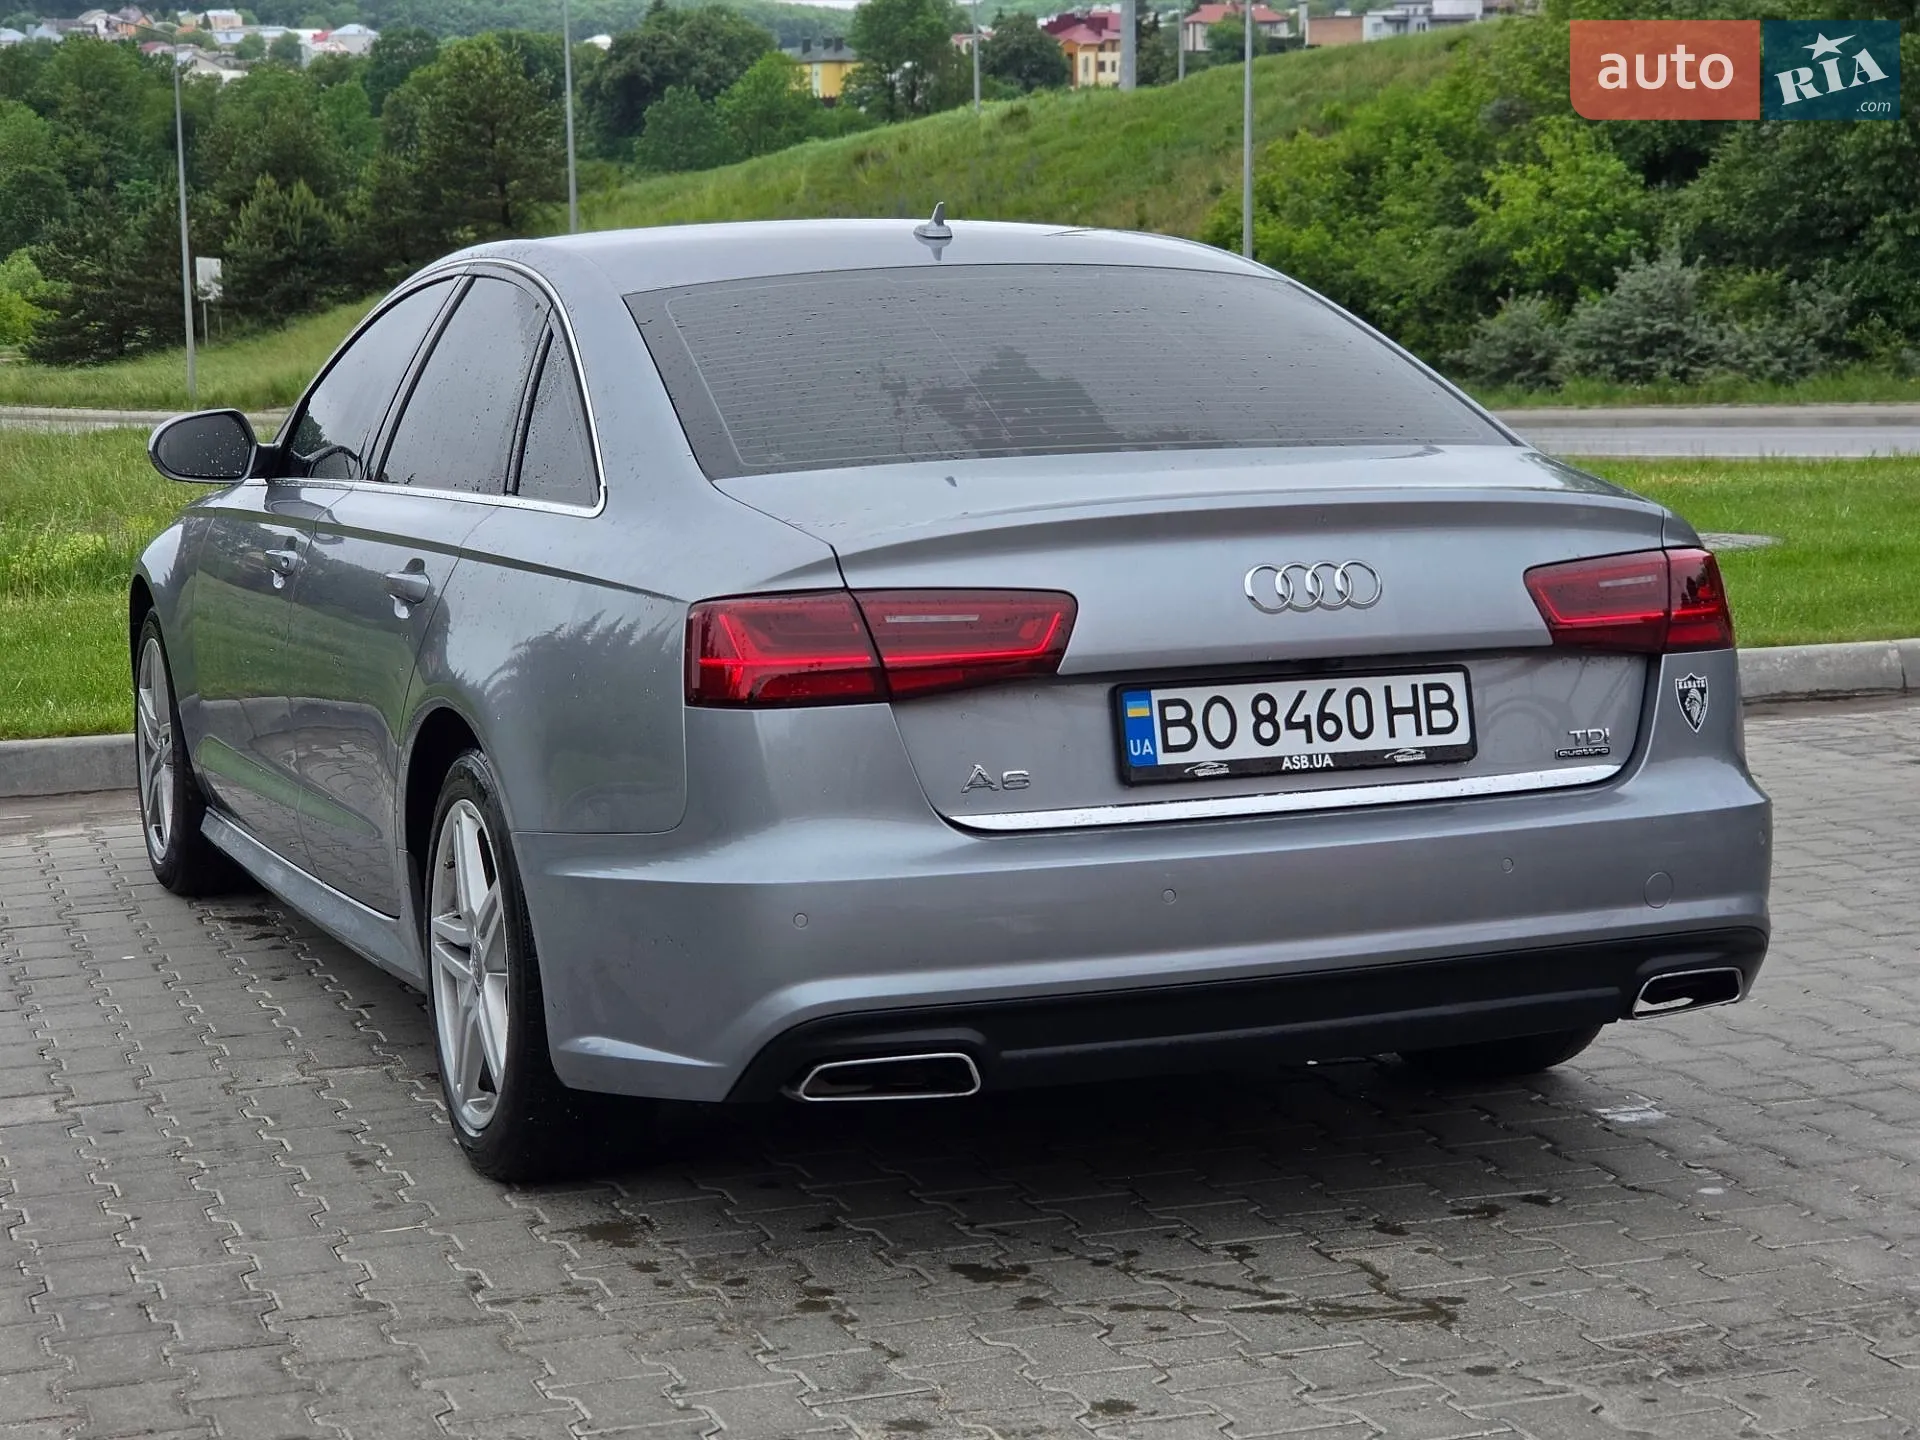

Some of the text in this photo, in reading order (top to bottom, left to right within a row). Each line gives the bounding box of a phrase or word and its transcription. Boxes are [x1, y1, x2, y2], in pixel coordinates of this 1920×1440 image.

[1157, 682, 1459, 754] BO 8460 HB
[1569, 727, 1610, 746] TDI
[1130, 738, 1154, 757] UA
[1281, 754, 1334, 771] ASB.UA
[961, 764, 1030, 793] A6
